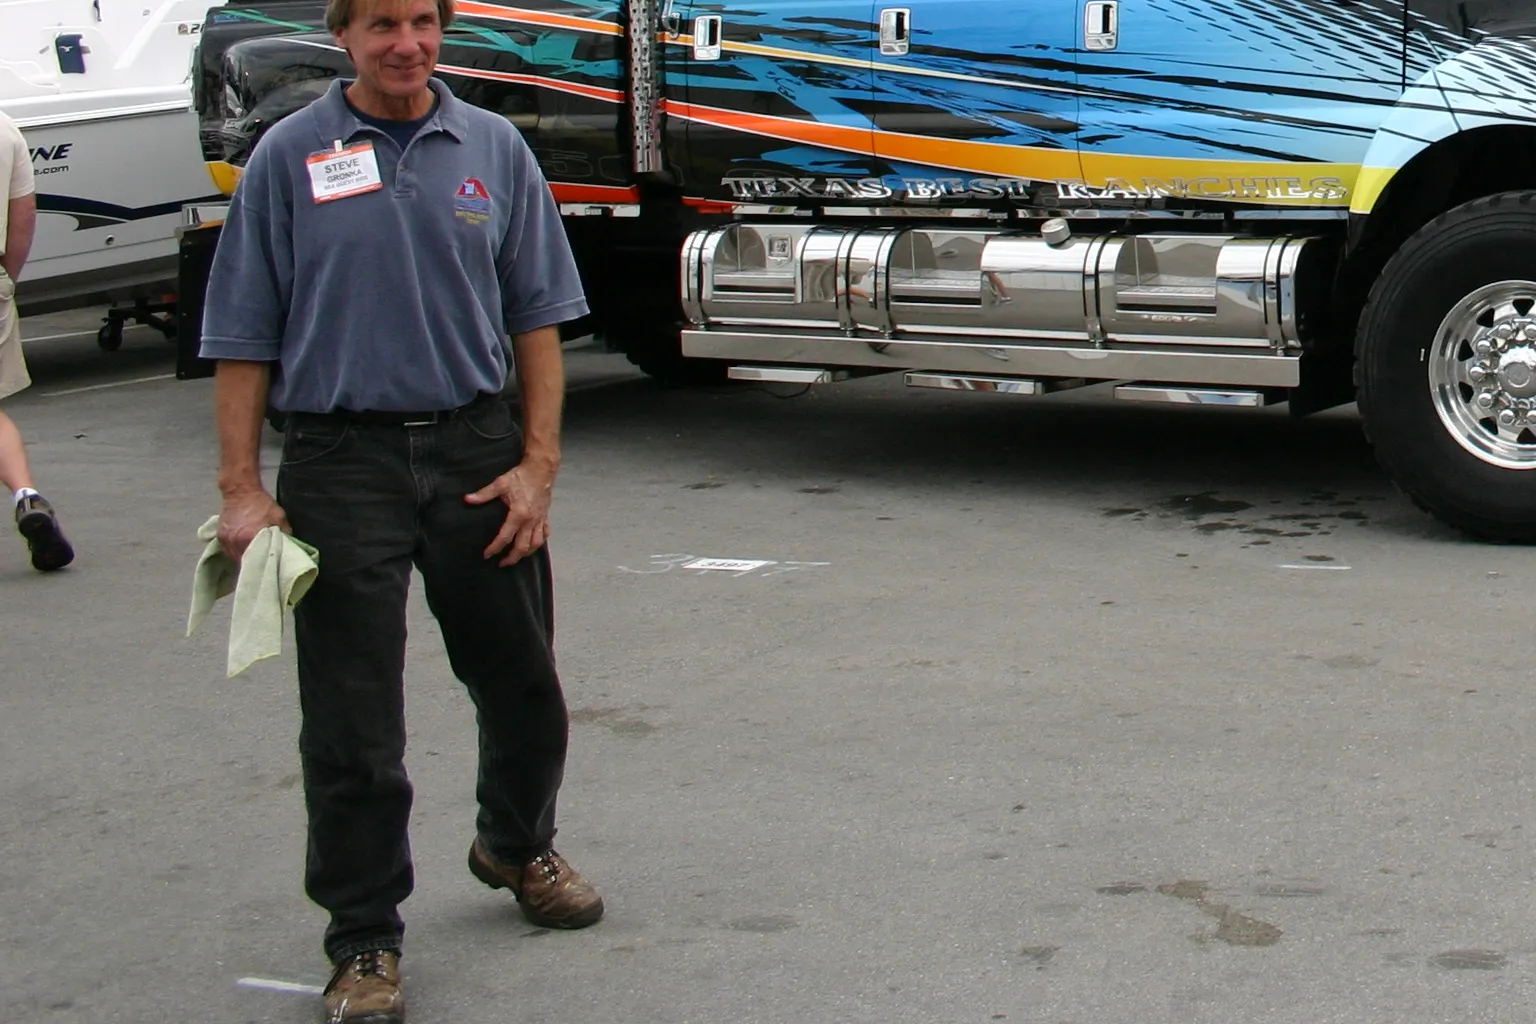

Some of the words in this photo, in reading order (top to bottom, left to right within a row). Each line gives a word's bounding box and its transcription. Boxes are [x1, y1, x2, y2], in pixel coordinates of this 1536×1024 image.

[324, 157, 360, 174] STEVE
[720, 177, 892, 198] TEXAS
[902, 177, 1031, 199] BEST
[1053, 176, 1349, 199] RANCHES
